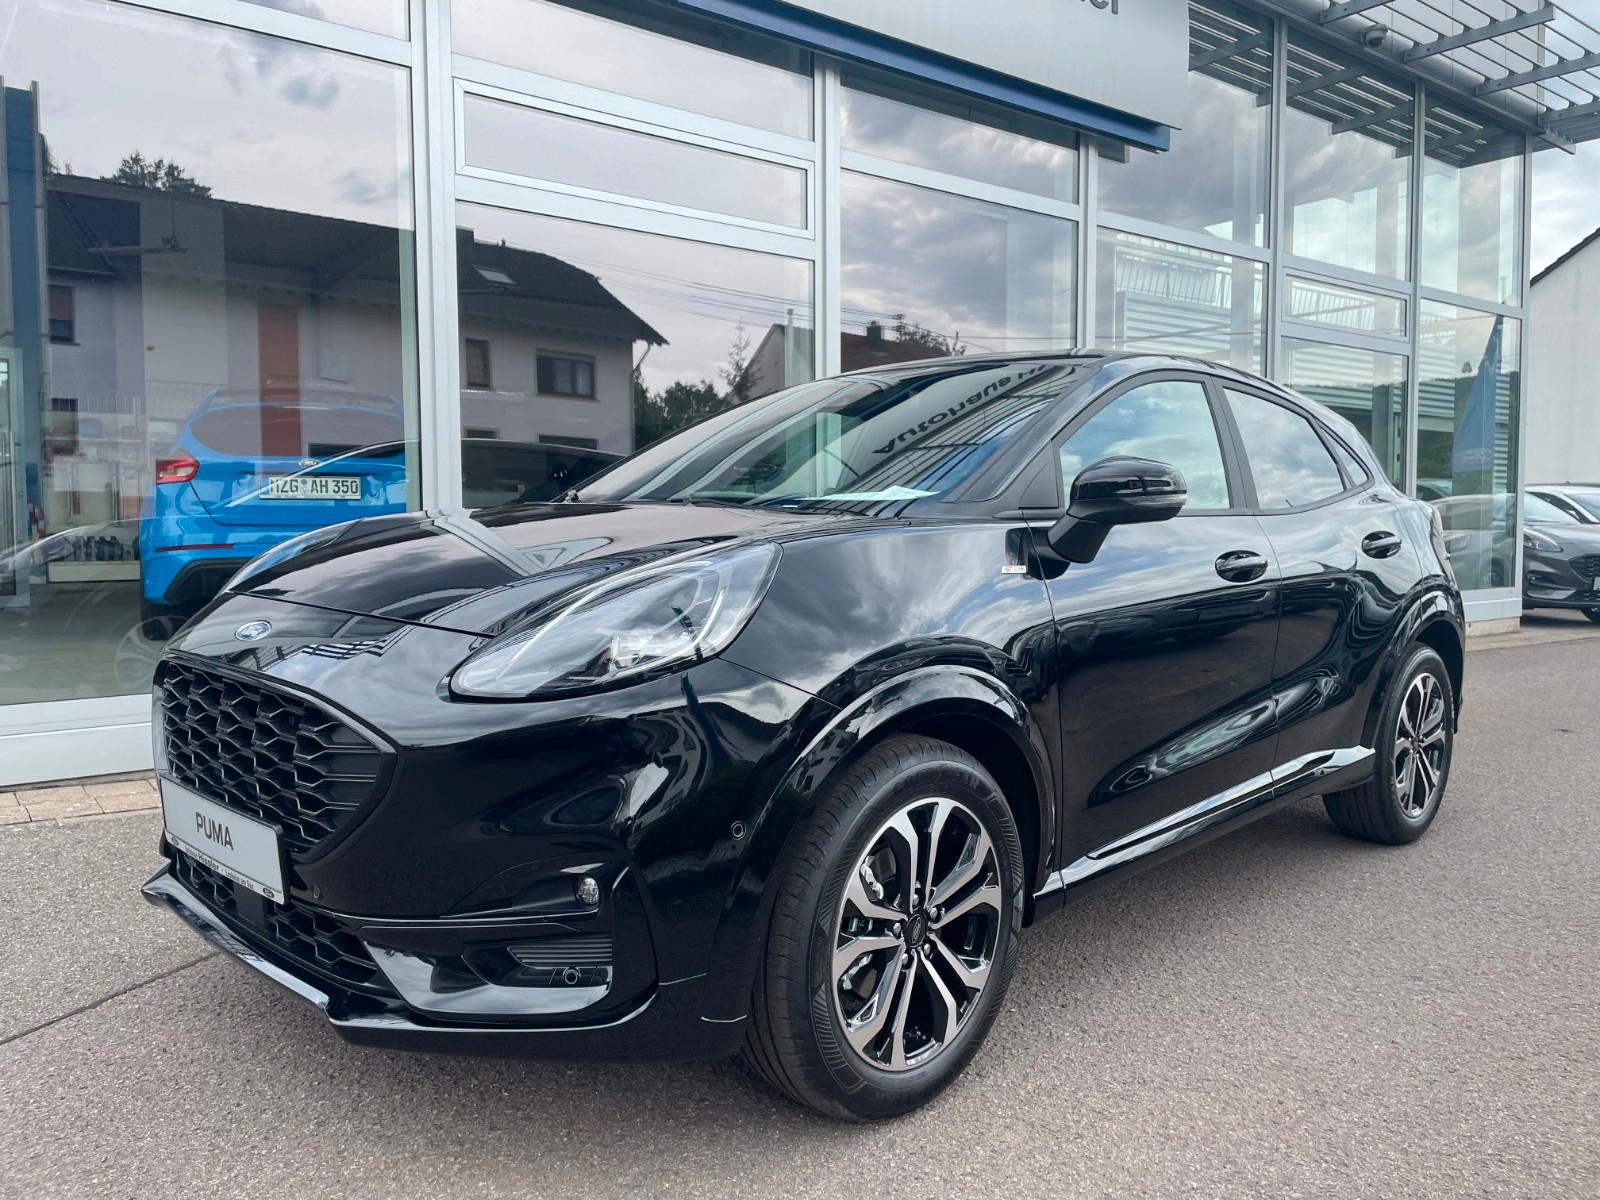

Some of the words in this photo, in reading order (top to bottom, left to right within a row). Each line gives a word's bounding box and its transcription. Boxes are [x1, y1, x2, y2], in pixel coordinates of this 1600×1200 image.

[310, 479, 329, 494] AH
[332, 480, 359, 495] 350
[196, 811, 234, 851] PUMA
